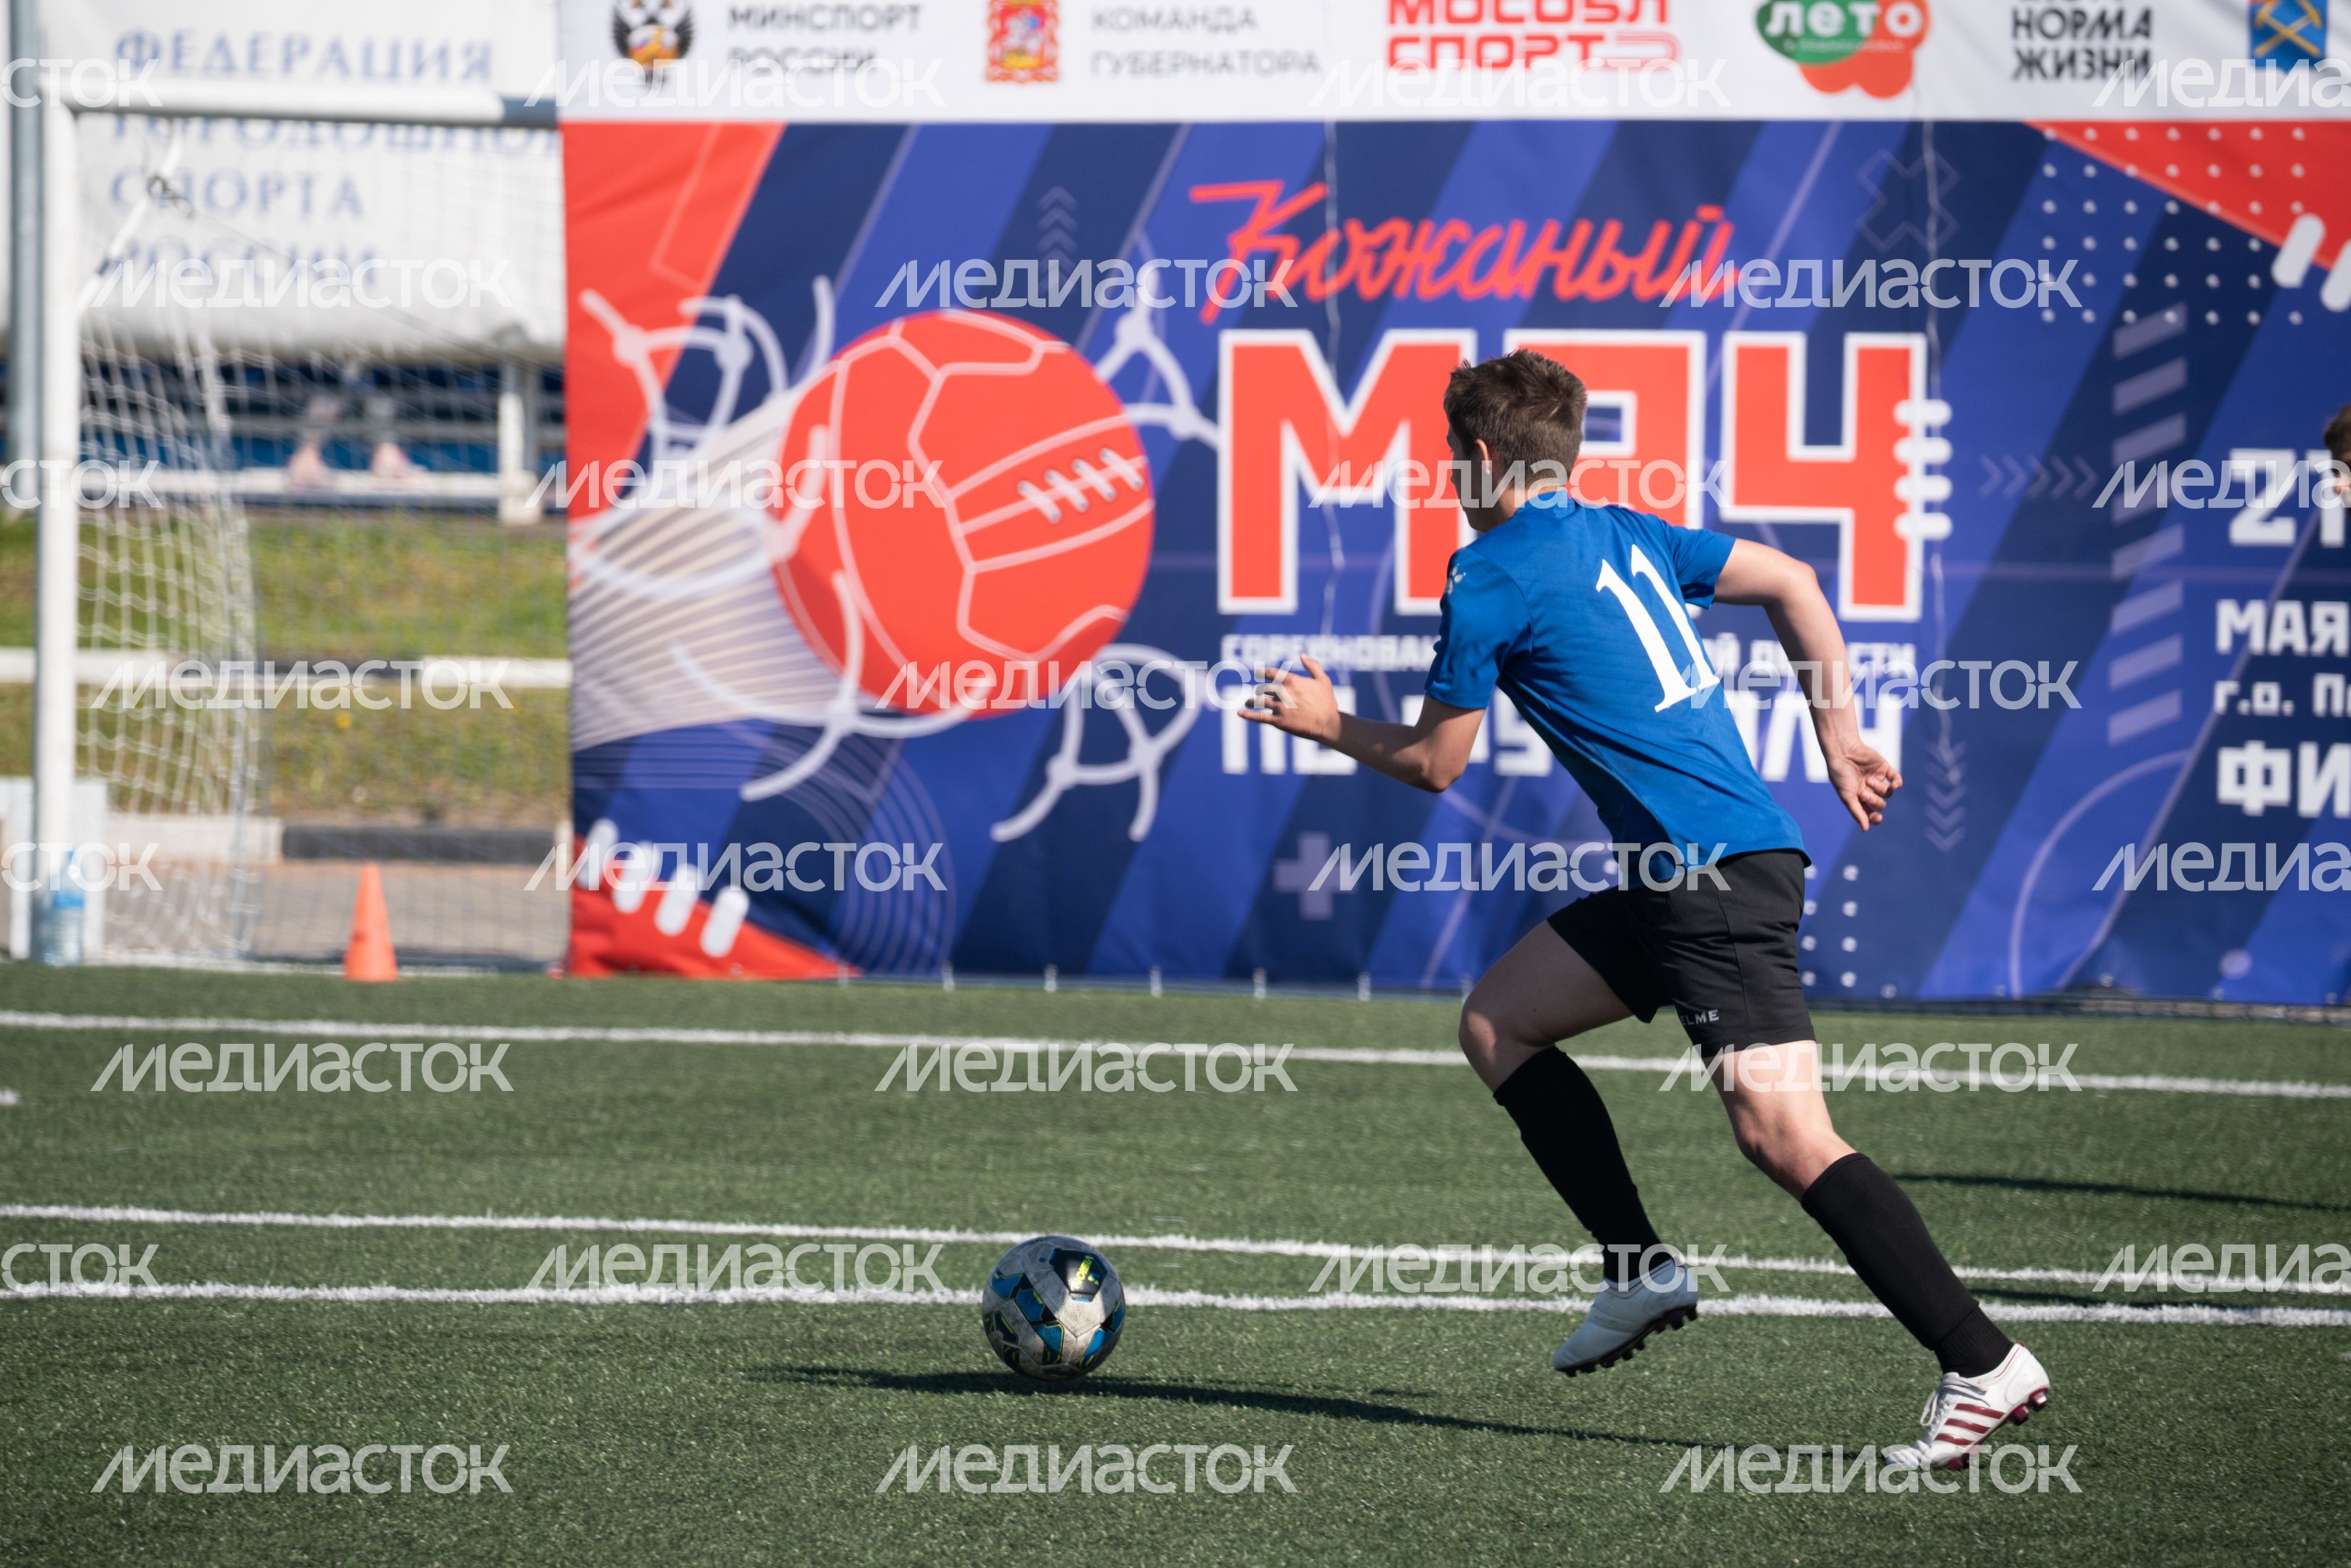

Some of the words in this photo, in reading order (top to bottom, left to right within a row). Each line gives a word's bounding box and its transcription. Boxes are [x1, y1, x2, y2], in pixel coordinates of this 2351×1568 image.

[728, 3, 922, 30] МИНСПОРТ
[1091, 6, 1258, 33] КОМАНДА
[2012, 8, 2152, 39] НОРМА
[113, 29, 493, 81] ФЕДЕРАЦИЯ
[1091, 49, 1321, 78] ГУБЕРНАТОРА
[1388, 33, 1606, 70] СПОРТ
[2013, 49, 2152, 81] ЖИЗНИ
[1189, 179, 1740, 325] Кожаный
[1594, 544, 1719, 713] 11
[2215, 599, 2350, 656] МАЯ
[1679, 1009, 1720, 1027] ELME
